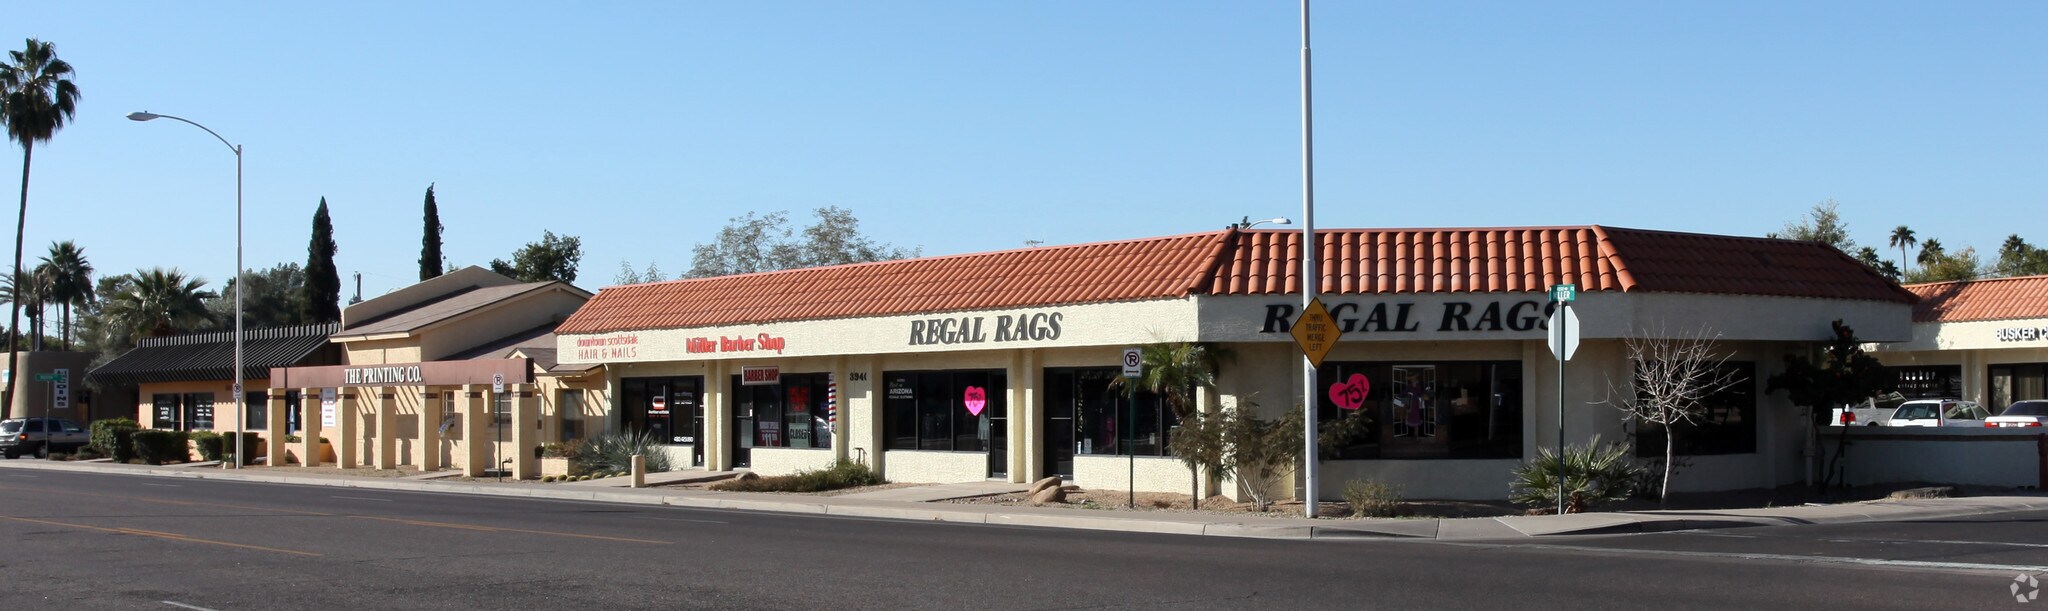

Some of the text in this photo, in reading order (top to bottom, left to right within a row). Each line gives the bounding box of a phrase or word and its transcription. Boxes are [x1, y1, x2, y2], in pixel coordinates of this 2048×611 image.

[1259, 302, 1419, 333] RGAL
[908, 311, 1064, 345] REGAL RAGS
[1305, 323, 1326, 332] TRAFFIC
[1995, 327, 2037, 341] BUSKER
[577, 334, 638, 348] downtown scottsdale
[686, 333, 785, 355] Miller Barber Shop
[1306, 333, 1325, 342] MERGE
[578, 346, 637, 360] HAIR & NAILS
[1309, 343, 1322, 351] LEFT
[344, 365, 422, 384] THE PRINTING CO.
[744, 368, 779, 382] BARBER SHOP
[790, 428, 807, 440] CLOSED
